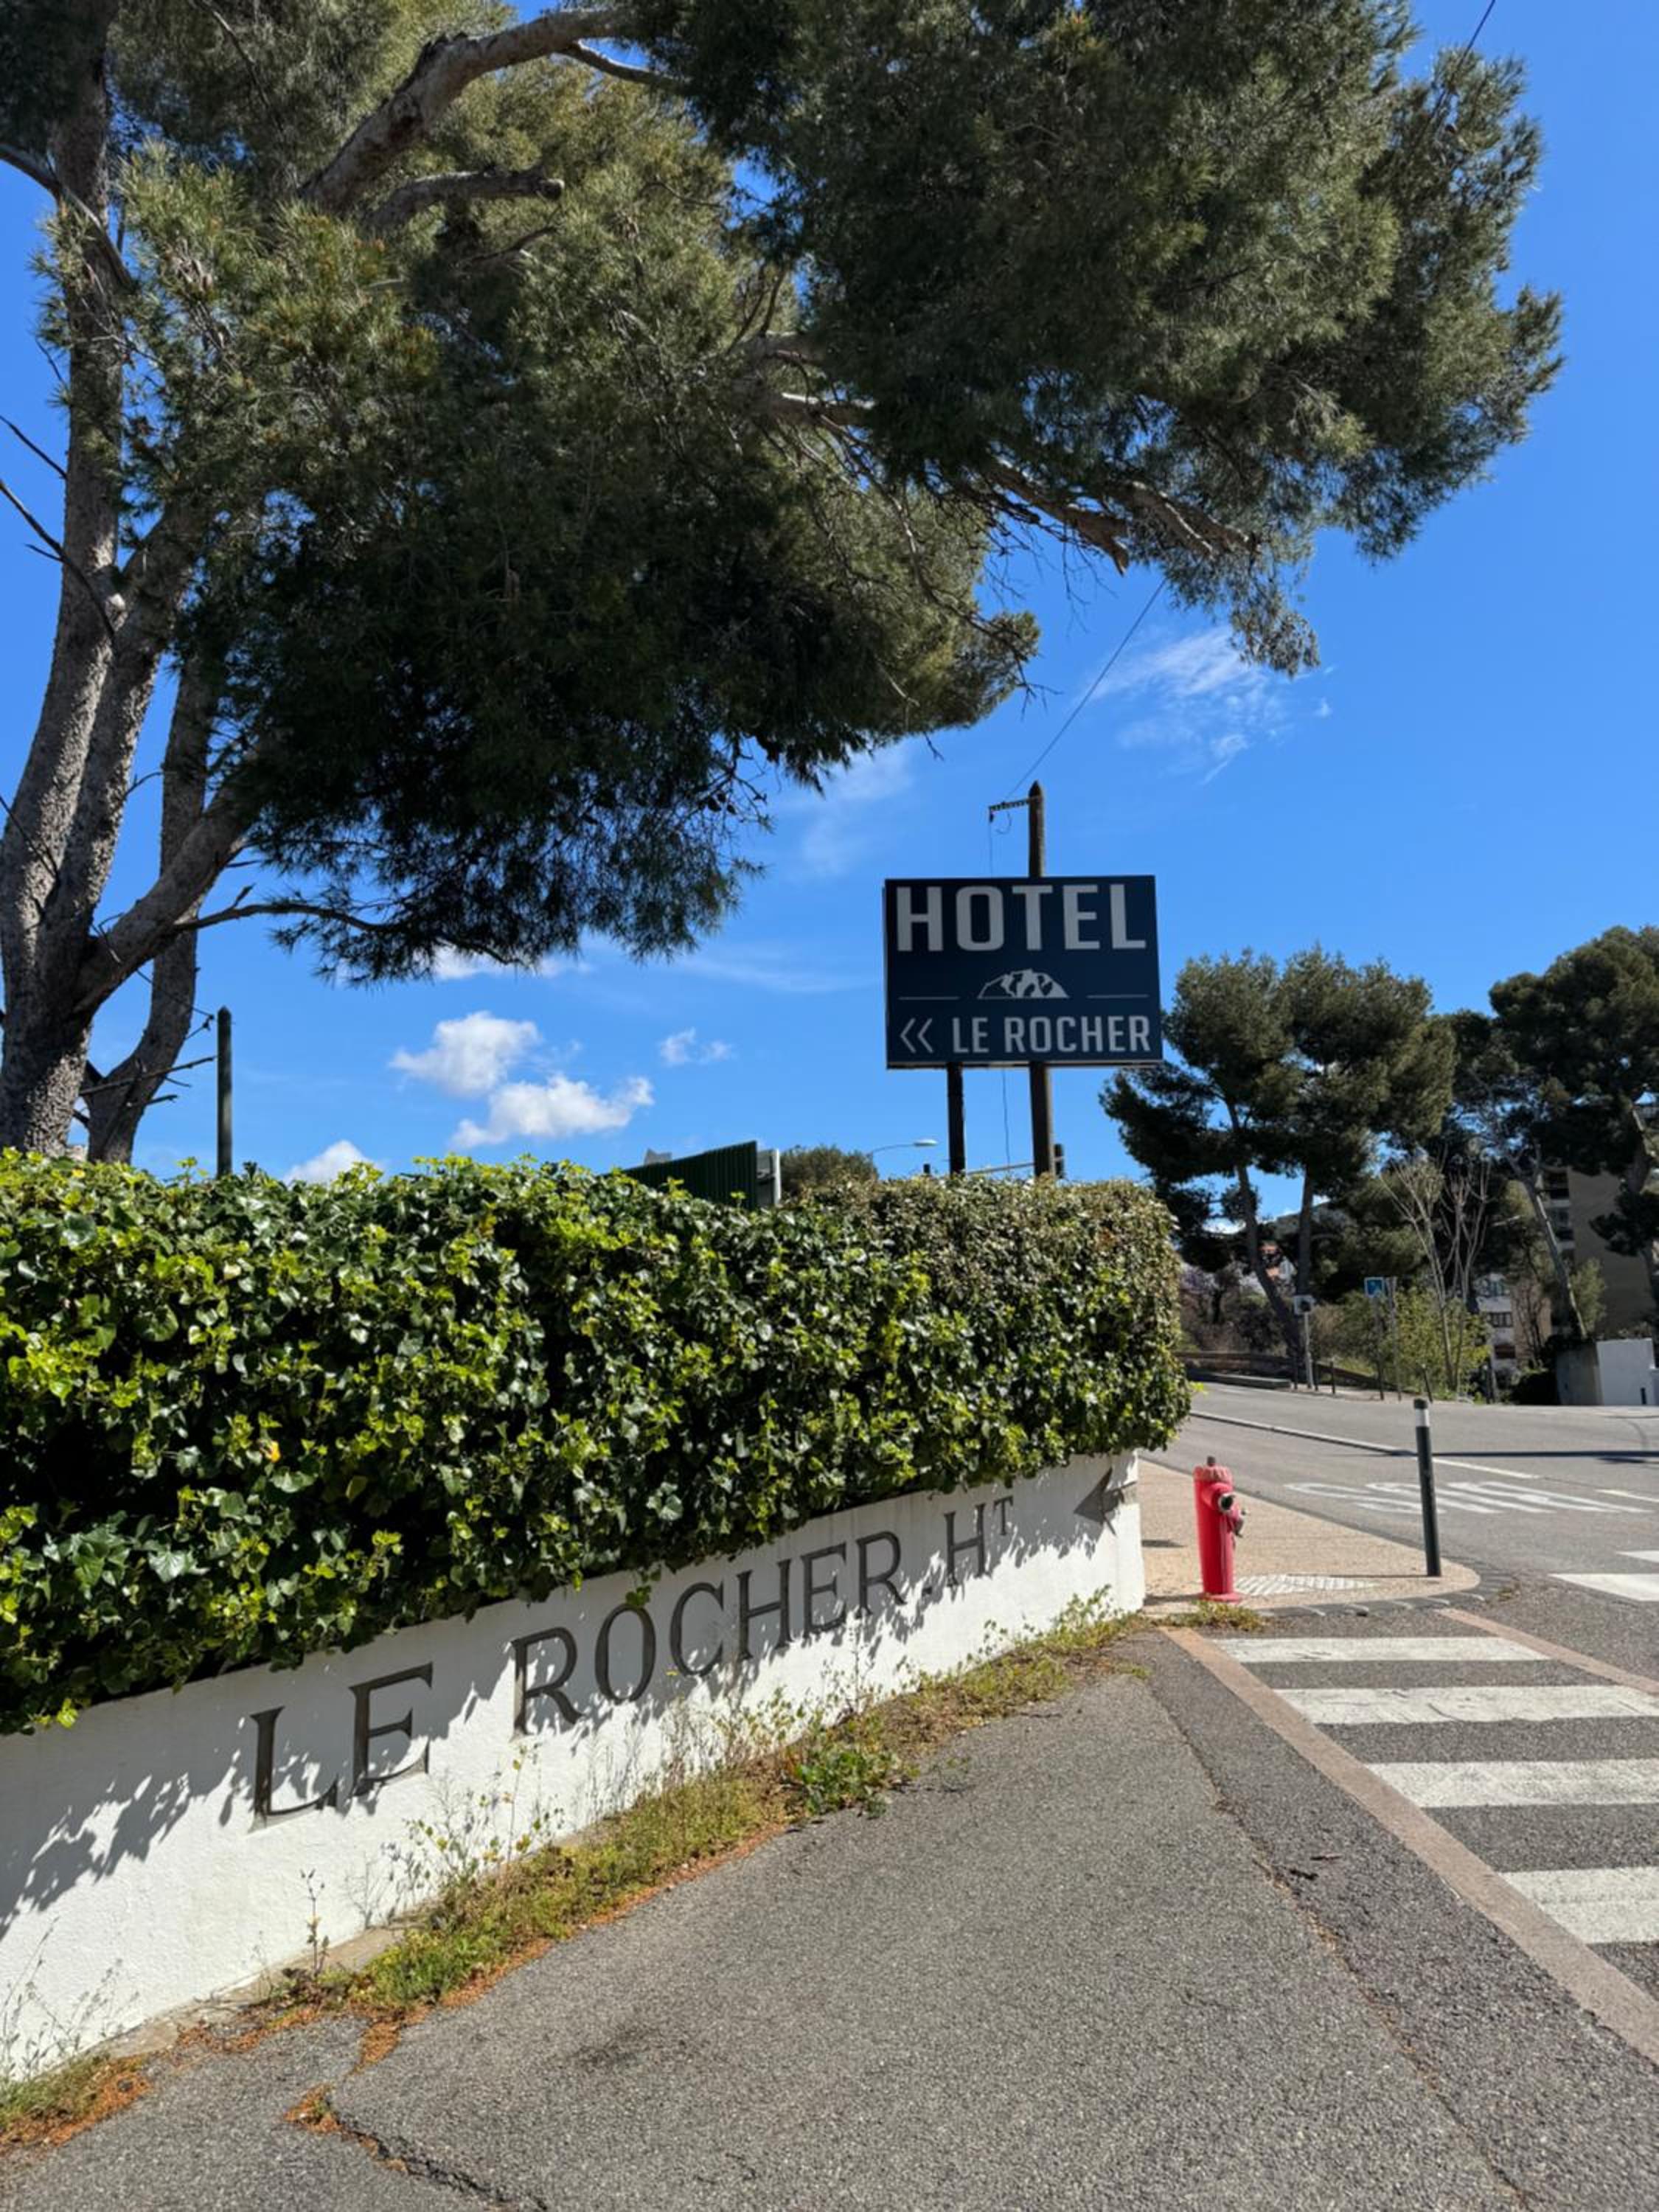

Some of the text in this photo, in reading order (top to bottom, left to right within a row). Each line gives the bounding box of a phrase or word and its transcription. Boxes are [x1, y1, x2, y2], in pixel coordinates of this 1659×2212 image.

[896, 884, 1147, 952] HOTEL
[952, 1015, 1151, 1054] LE ROCHER
[248, 1662, 434, 1833] LE
